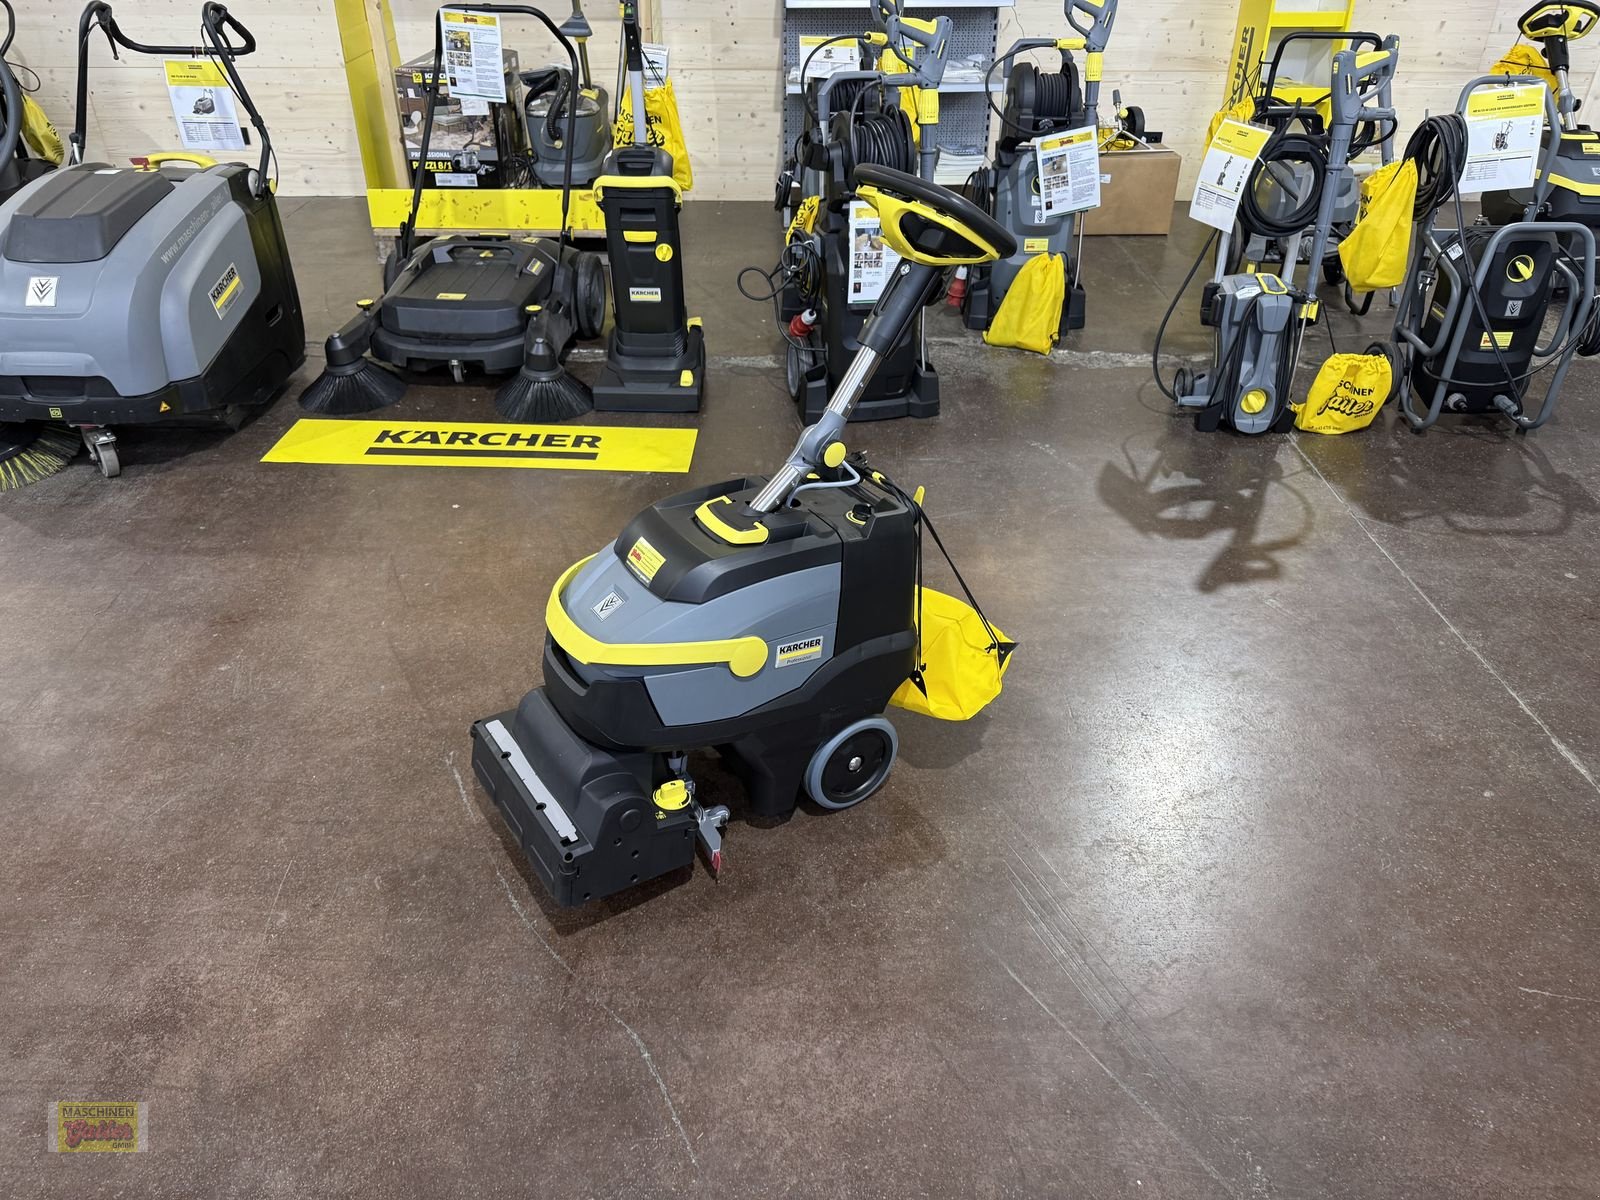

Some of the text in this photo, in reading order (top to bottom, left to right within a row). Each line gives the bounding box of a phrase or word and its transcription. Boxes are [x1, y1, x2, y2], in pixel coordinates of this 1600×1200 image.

[412, 161, 437, 170] PZZI
[374, 429, 602, 449] KÄRCHER
[779, 638, 821, 655] KÄRCHER
